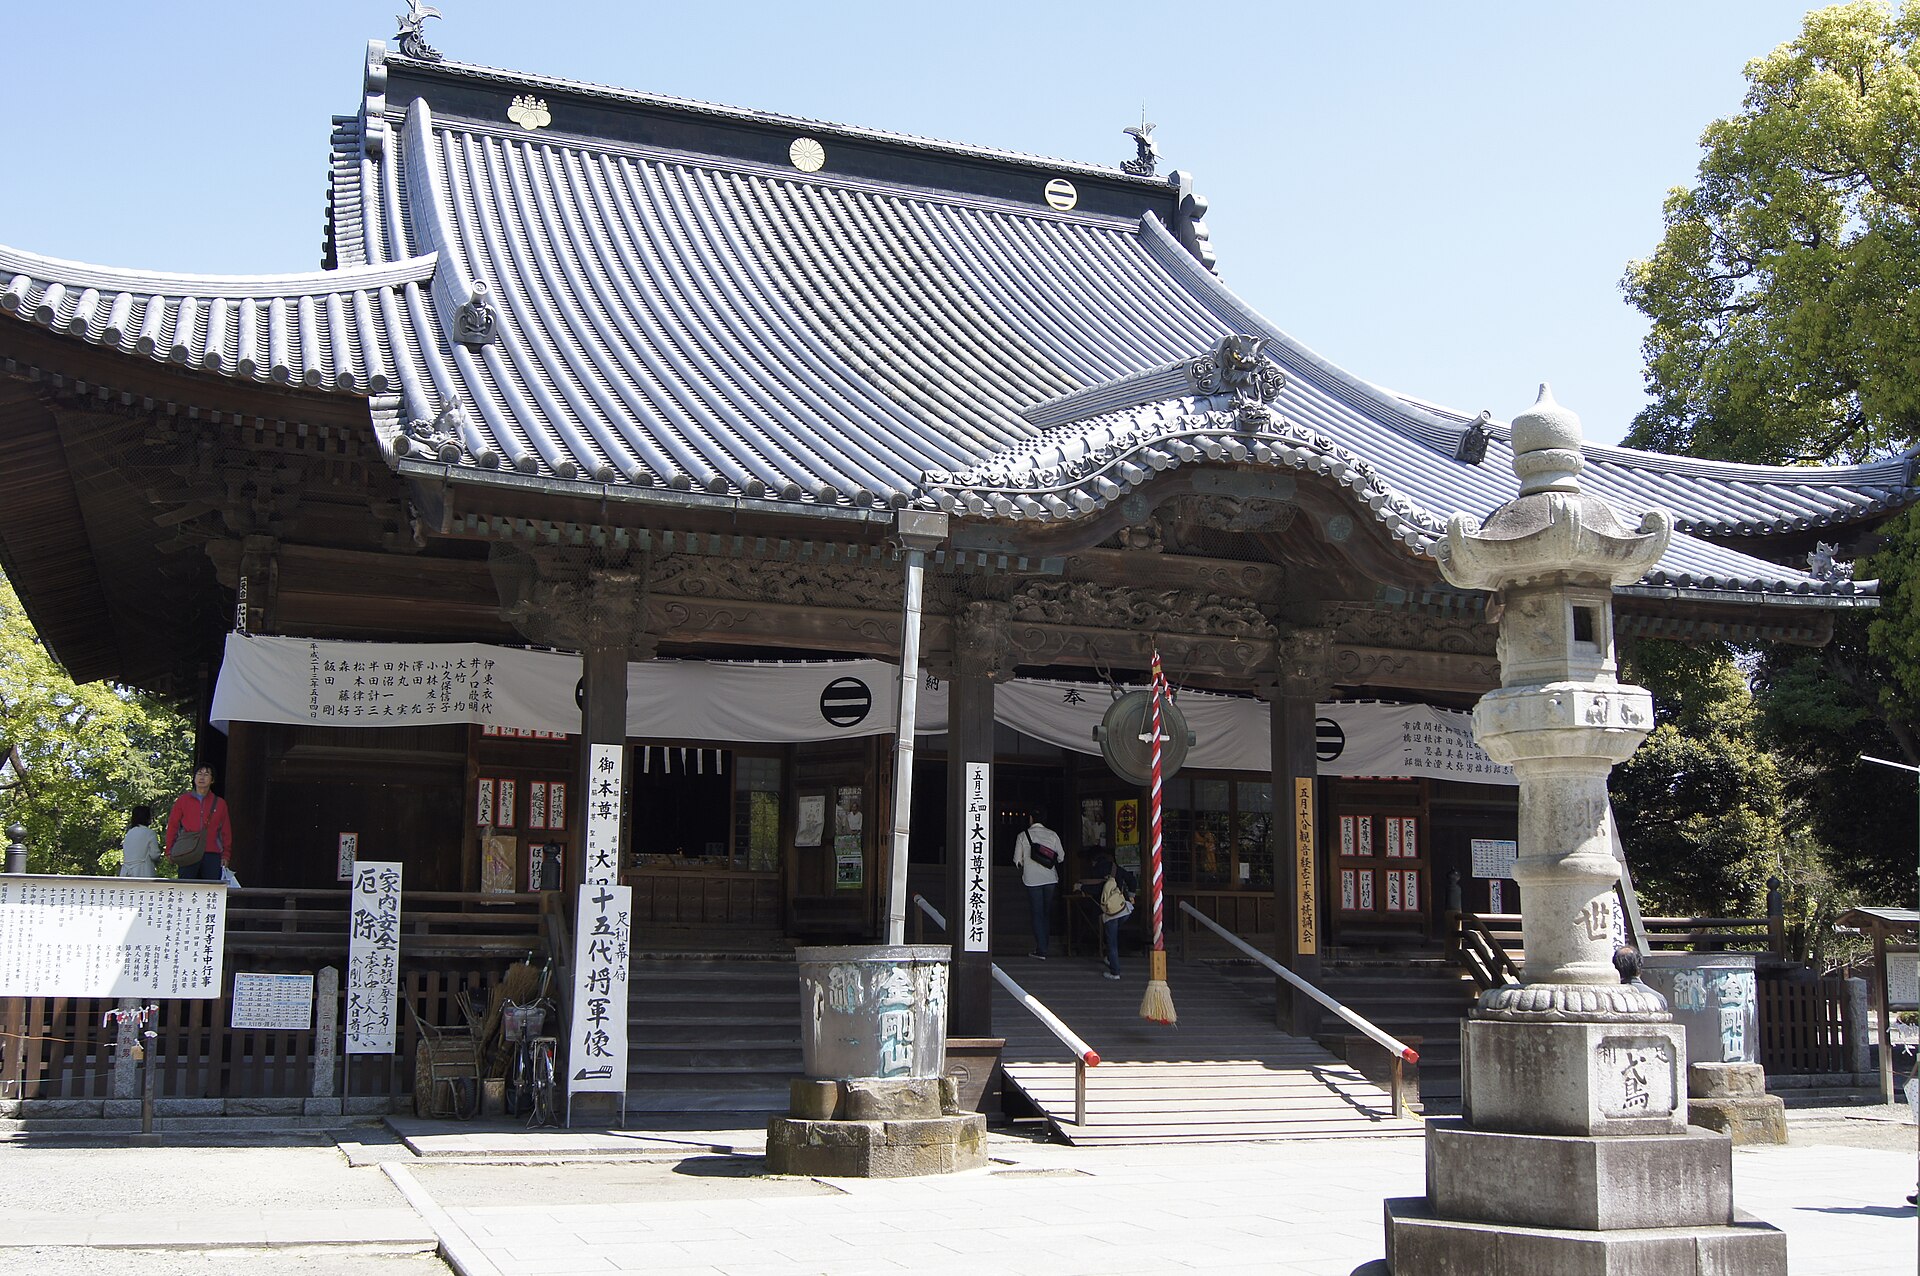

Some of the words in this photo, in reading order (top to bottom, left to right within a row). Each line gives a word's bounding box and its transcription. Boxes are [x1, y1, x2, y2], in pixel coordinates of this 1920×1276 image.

[309, 643, 319, 718] 平成二十三年五月四日
[353, 661, 366, 716] 松本律子
[382, 661, 395, 716] 田沼一夫
[440, 661, 453, 713] 小久保信子
[925, 675, 940, 691] 納
[1063, 689, 1086, 706] 奉
[597, 756, 615, 821] 御本尊
[353, 868, 379, 940] 厄除
[373, 867, 400, 951] 家内安全
[1573, 900, 1610, 942] 世
[584, 886, 616, 1058] 十五代将軍像
[613, 911, 629, 982] 足利幕府
[828, 966, 865, 1013] 納
[879, 966, 916, 1077] 金剛山
[1717, 972, 1743, 1061] 金剛山
